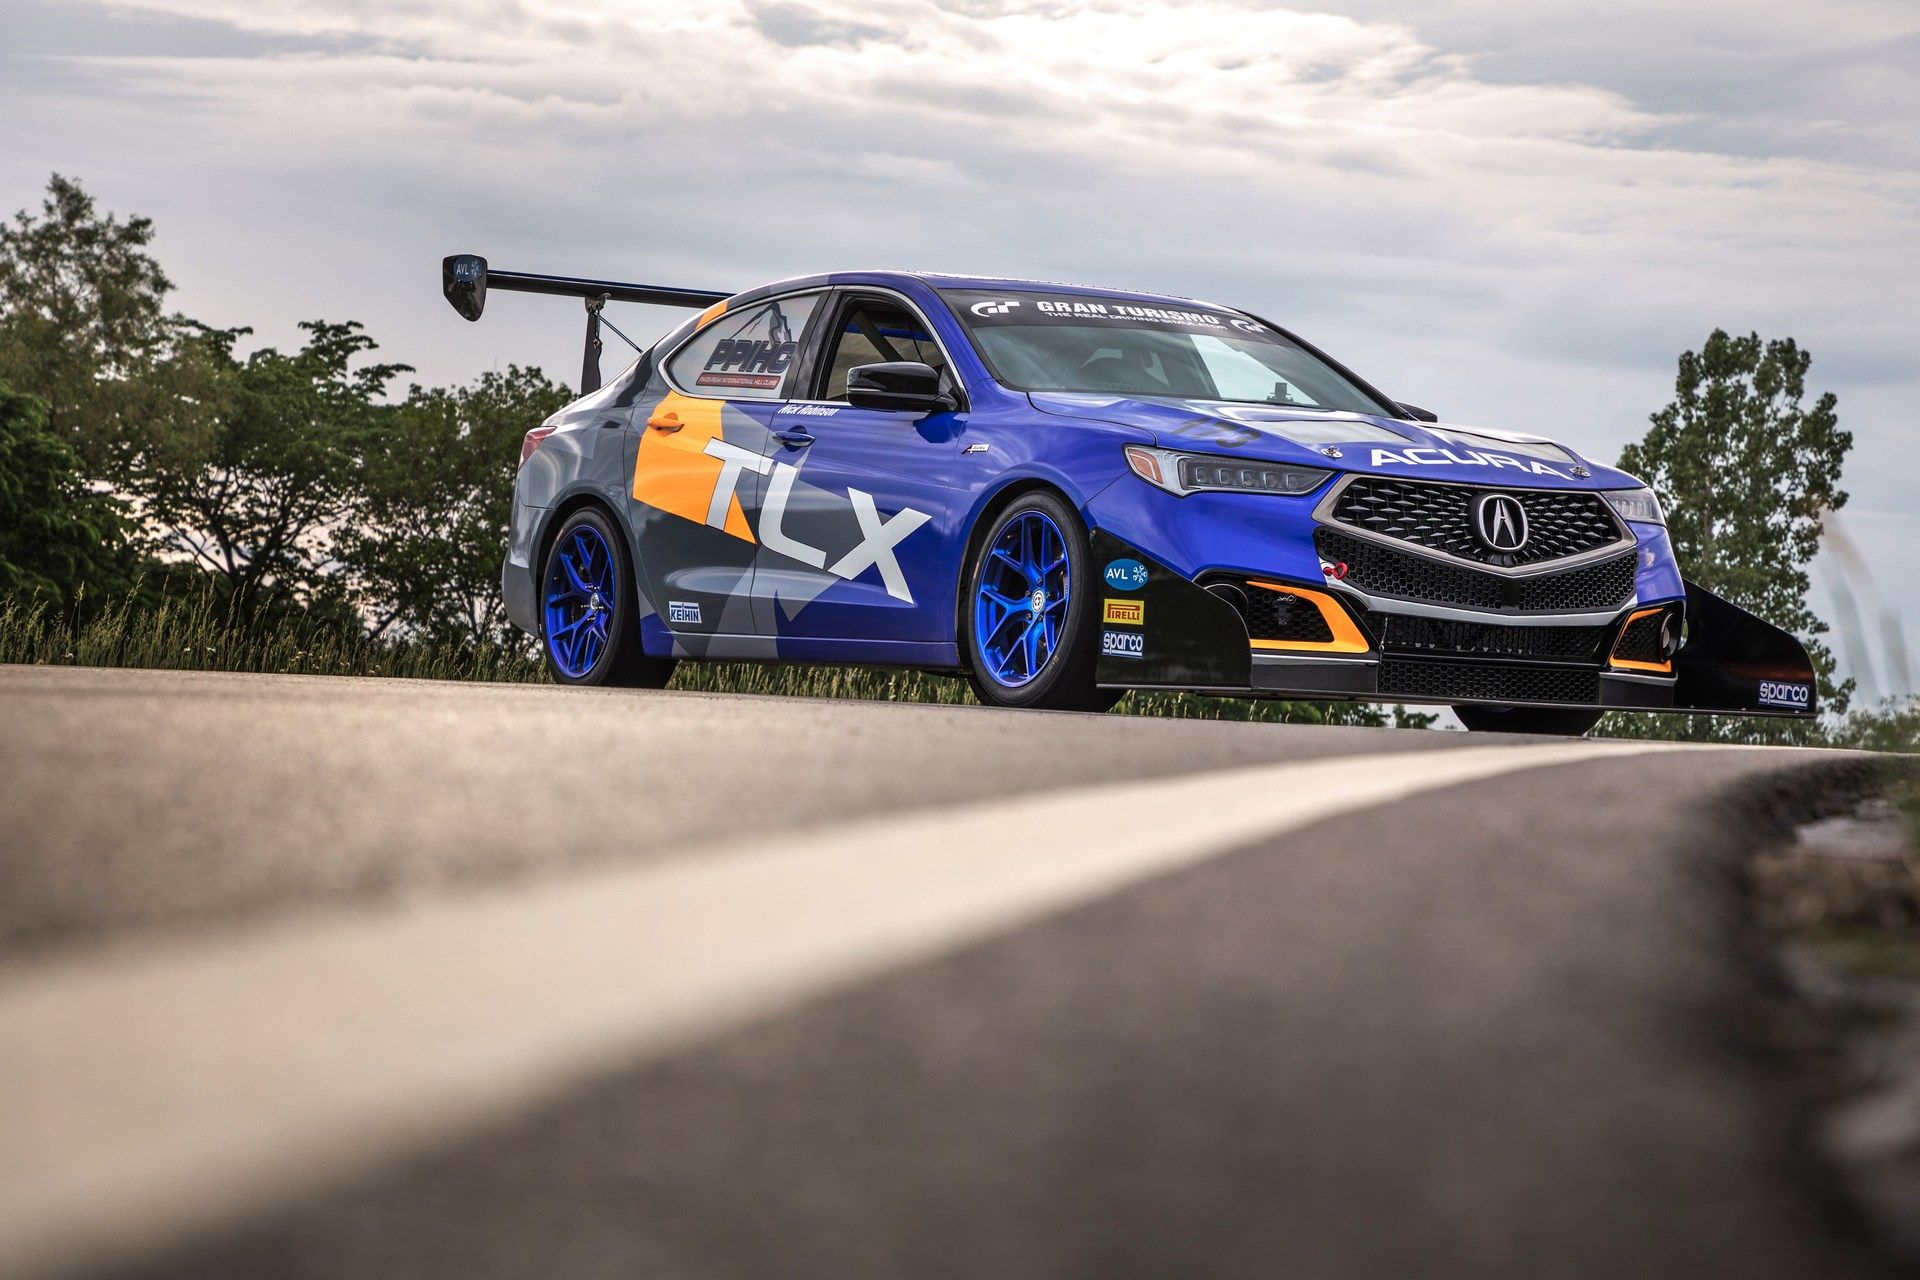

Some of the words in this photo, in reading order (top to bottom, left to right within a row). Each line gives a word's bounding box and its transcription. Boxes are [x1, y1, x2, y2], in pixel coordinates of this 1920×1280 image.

[456, 263, 469, 275] AVL
[1036, 301, 1108, 314] GRAN
[1112, 305, 1221, 325] TURISMO
[1110, 315, 1156, 323] DRIVING
[1159, 318, 1230, 331] SIMULATOR
[1371, 448, 1575, 481] ACURA
[702, 437, 933, 605] TLX
[1106, 568, 1128, 580] AVL
[670, 603, 699, 621] KEIHIN
[1107, 603, 1141, 621] PIRELLI
[1103, 632, 1144, 655] sparco
[1759, 682, 1809, 704] sparco
